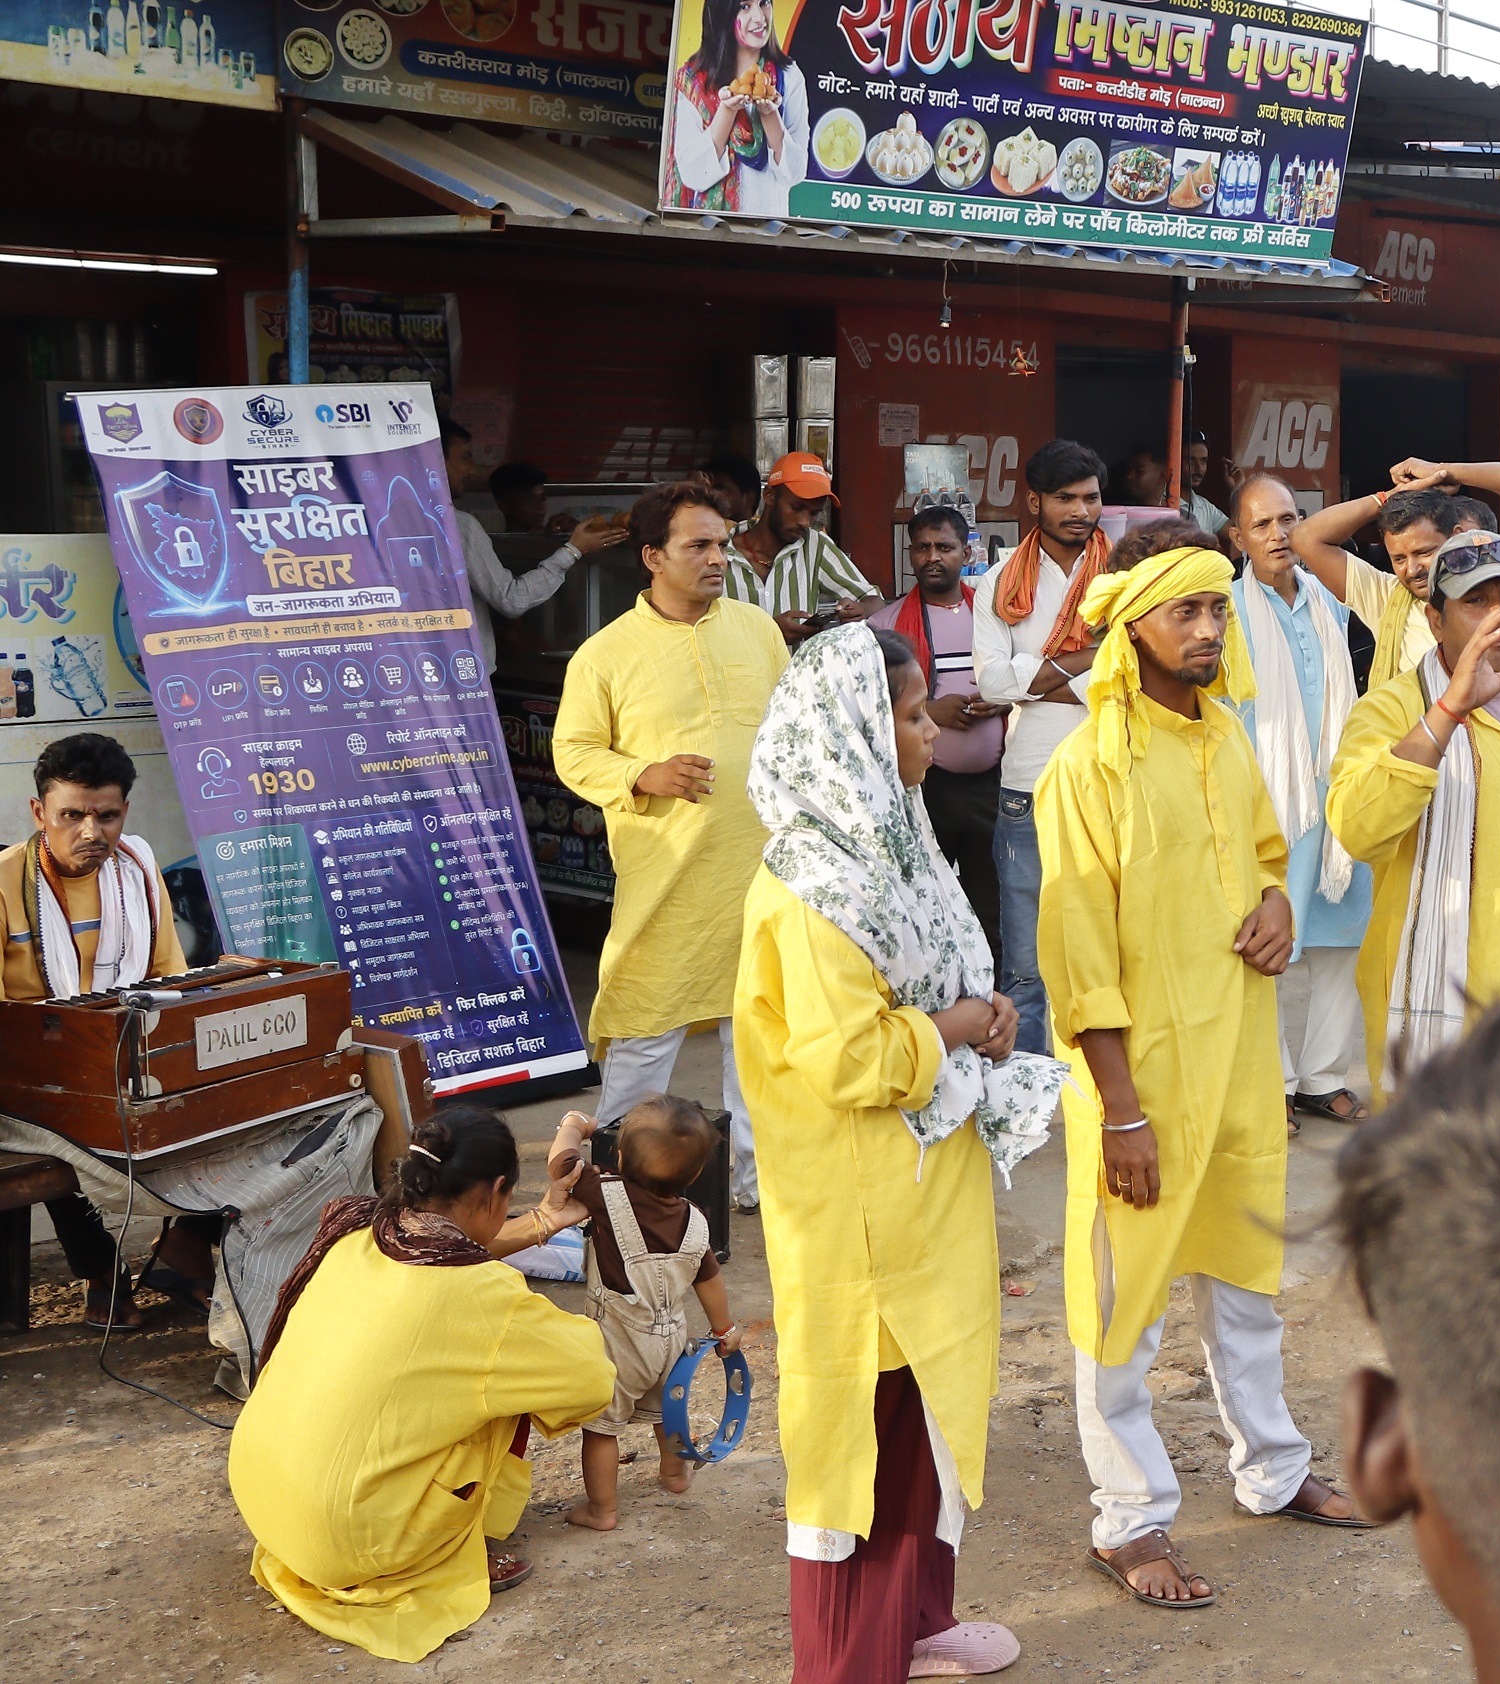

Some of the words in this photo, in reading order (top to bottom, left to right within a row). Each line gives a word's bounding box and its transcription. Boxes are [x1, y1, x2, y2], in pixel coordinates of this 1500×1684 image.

[1291, 11, 1363, 37] 8292690364
[417, 48, 513, 77] कतरीसराय
[516, 63, 550, 86] मोड़
[1227, 22, 1356, 102] भण्डार
[341, 75, 393, 97] हमारे
[398, 77, 434, 100] यहाँ
[1095, 80, 1147, 100] कतरीडीह
[1149, 89, 1172, 107] मोड़
[1175, 88, 1225, 114] (नालन्दा)
[865, 79, 897, 101] हमारे
[900, 82, 926, 104] यहाँ
[971, 90, 1000, 115] पार्टी
[1002, 96, 1023, 117] एवं
[1024, 103, 1055, 121] अन्य
[1057, 107, 1096, 128] अवसर
[1098, 112, 1114, 129] पर
[1116, 112, 1159, 134] कारीगर
[1160, 116, 1174, 135] के
[1177, 118, 1201, 139] लिए
[1202, 122, 1240, 144] सम्पर्क
[1257, 102, 1279, 119] अच्छी
[1279, 106, 1304, 131] खुशबू
[1304, 110, 1327, 128] बेहतर
[1328, 113, 1346, 130] स्वाद
[830, 190, 861, 210] 500
[866, 193, 924, 216] रूपया
[928, 199, 956, 219] का
[960, 202, 1020, 224] सामान
[1024, 202, 1058, 228] लेने
[1062, 211, 1086, 230] पर
[1089, 209, 1121, 233] पाँच
[1126, 211, 1208, 240] किलोमीटर
[1209, 224, 1240, 242] तक
[1242, 223, 1264, 245] फ्री
[1267, 225, 1310, 248] सर्विस
[1374, 230, 1436, 282] ACC
[336, 403, 371, 423] SBI
[246, 435, 300, 445] SECURE
[250, 428, 294, 437] CYBER
[1241, 400, 1333, 469] ACC
[233, 461, 337, 498] साइबर
[230, 494, 369, 554] सुरक्षित
[262, 548, 356, 589] बिहार
[253, 596, 344, 614] जन-जागरूकता
[347, 591, 395, 607] अभियान
[175, 632, 225, 648] जागरूकता
[227, 628, 238, 640] ही
[240, 626, 262, 641] सुरक्षा
[263, 625, 270, 638] है
[282, 621, 320, 636] सावधानी
[322, 619, 332, 634] ही
[334, 621, 356, 633] बचाव
[358, 618, 365, 631] है
[376, 615, 400, 630] सतर्क
[415, 614, 443, 630] सुरक्षित
[444, 613, 455, 627] रहें
[277, 645, 311, 659] सामान्य
[312, 643, 341, 656] साइबर
[343, 640, 373, 653] अपराध
[212, 681, 237, 696] UPI
[173, 720, 188, 730] OTP
[222, 714, 235, 724] UPI
[241, 742, 274, 754] साइबर
[275, 739, 303, 751] क्राइम
[386, 729, 412, 745] रिपोर्ट
[413, 726, 453, 741] ऑनलाइन
[453, 723, 466, 738] करें
[259, 755, 295, 768] हेल्पलाइन
[360, 748, 489, 775] www.cybercrime.gov.in
[247, 769, 316, 796] 1930
[252, 807, 272, 818] समय
[273, 807, 283, 817] पर
[283, 802, 318, 815] शिकायत
[319, 800, 338, 811] करने
[338, 799, 346, 810] से
[347, 799, 361, 808] धन
[361, 796, 373, 807] की
[373, 793, 400, 806] रिकवरी
[401, 791, 412, 802] की
[413, 788, 443, 801] संभावना
[456, 784, 473, 796] जाती
[440, 813, 477, 827] ऑनलाइन
[478, 808, 501, 826] सुरक्षित
[502, 806, 512, 821] रहें
[239, 838, 268, 854] हमारा
[268, 834, 293, 849] मिशन
[331, 827, 363, 842] अभियान
[363, 823, 373, 838] की
[379, 1007, 425, 1026] सत्यापित
[426, 1000, 444, 1018] करें
[455, 998, 477, 1012] फिर
[477, 991, 508, 1008] क्लिक
[509, 986, 526, 1002] करें
[205, 1022, 259, 1054] PAUL
[442, 1024, 455, 1040] रहें
[486, 1016, 516, 1034] सुरक्षित
[517, 1010, 530, 1026] रहें
[437, 1049, 482, 1070] डिजिटल
[483, 1042, 515, 1060] सशक्त
[516, 1036, 547, 1053] बिहार
